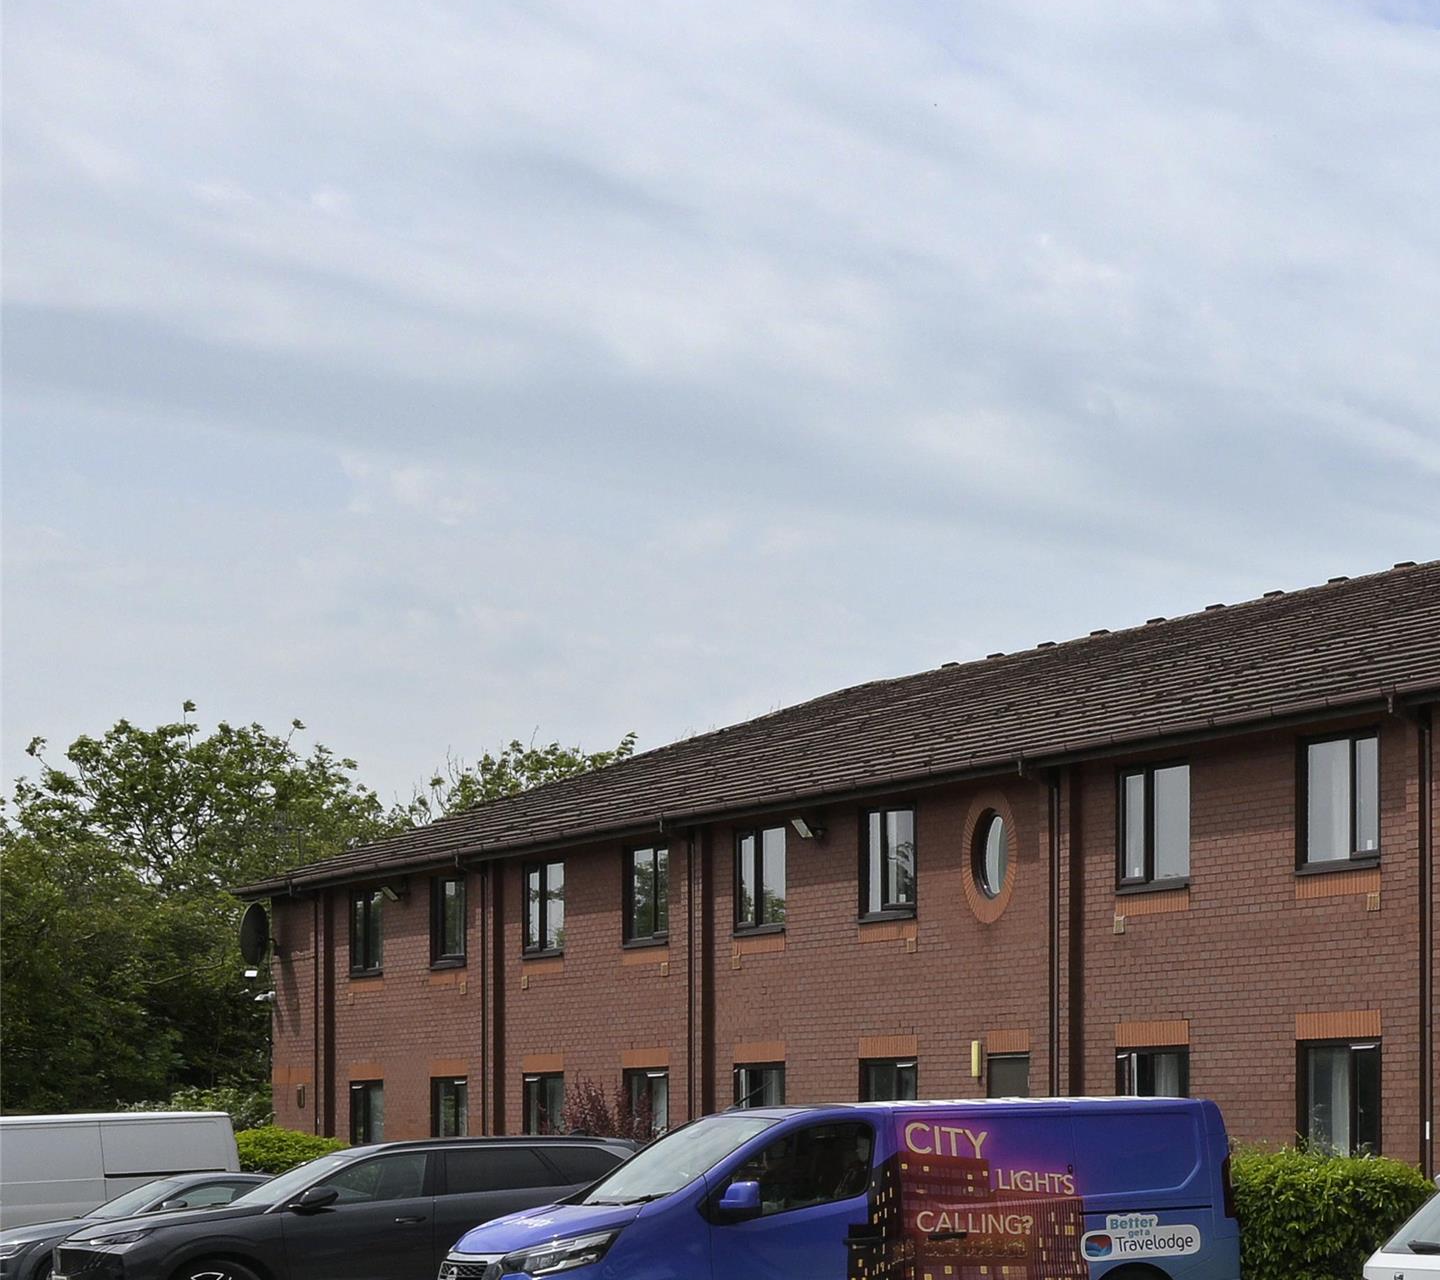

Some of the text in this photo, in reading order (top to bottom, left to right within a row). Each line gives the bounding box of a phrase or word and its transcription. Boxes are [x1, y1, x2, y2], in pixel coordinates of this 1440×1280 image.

[905, 1122, 988, 1159] CITY
[995, 1169, 1075, 1195] LIGHTS
[916, 1211, 1034, 1236] CALLING?
[1110, 1216, 1154, 1230] Better
[1128, 1228, 1143, 1238] get
[1114, 1233, 1194, 1252] Travelodge
